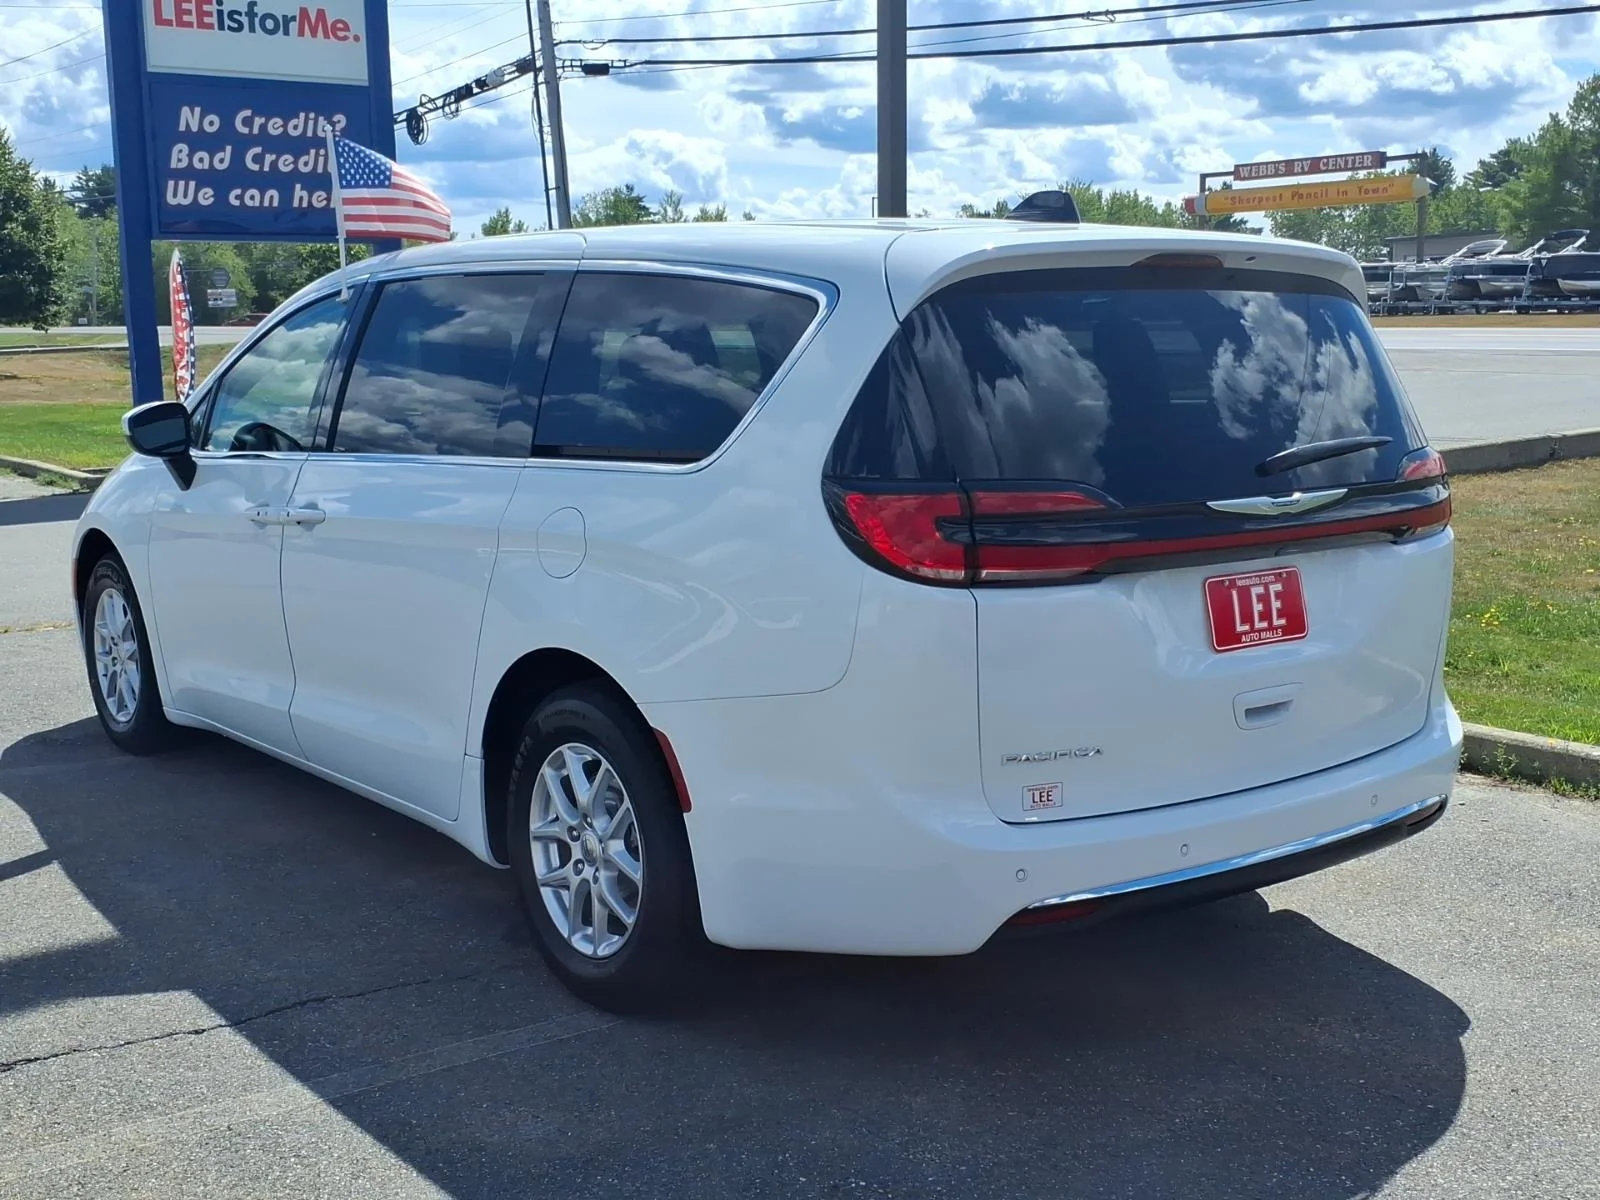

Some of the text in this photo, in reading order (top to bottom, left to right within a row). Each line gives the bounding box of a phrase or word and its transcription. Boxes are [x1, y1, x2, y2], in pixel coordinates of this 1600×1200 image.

[153, 0, 361, 43] LEEisforMe.
[178, 106, 347, 137] No Credit?
[170, 143, 232, 170] Bad
[1238, 154, 1373, 178] WEBB'S RV CENTER
[166, 180, 335, 209] We can he
[1231, 583, 1287, 633] LEE
[1241, 629, 1283, 643] AUTO MALLS
[1001, 746, 1103, 766] PACIFICA
[1032, 790, 1053, 804] LEE
